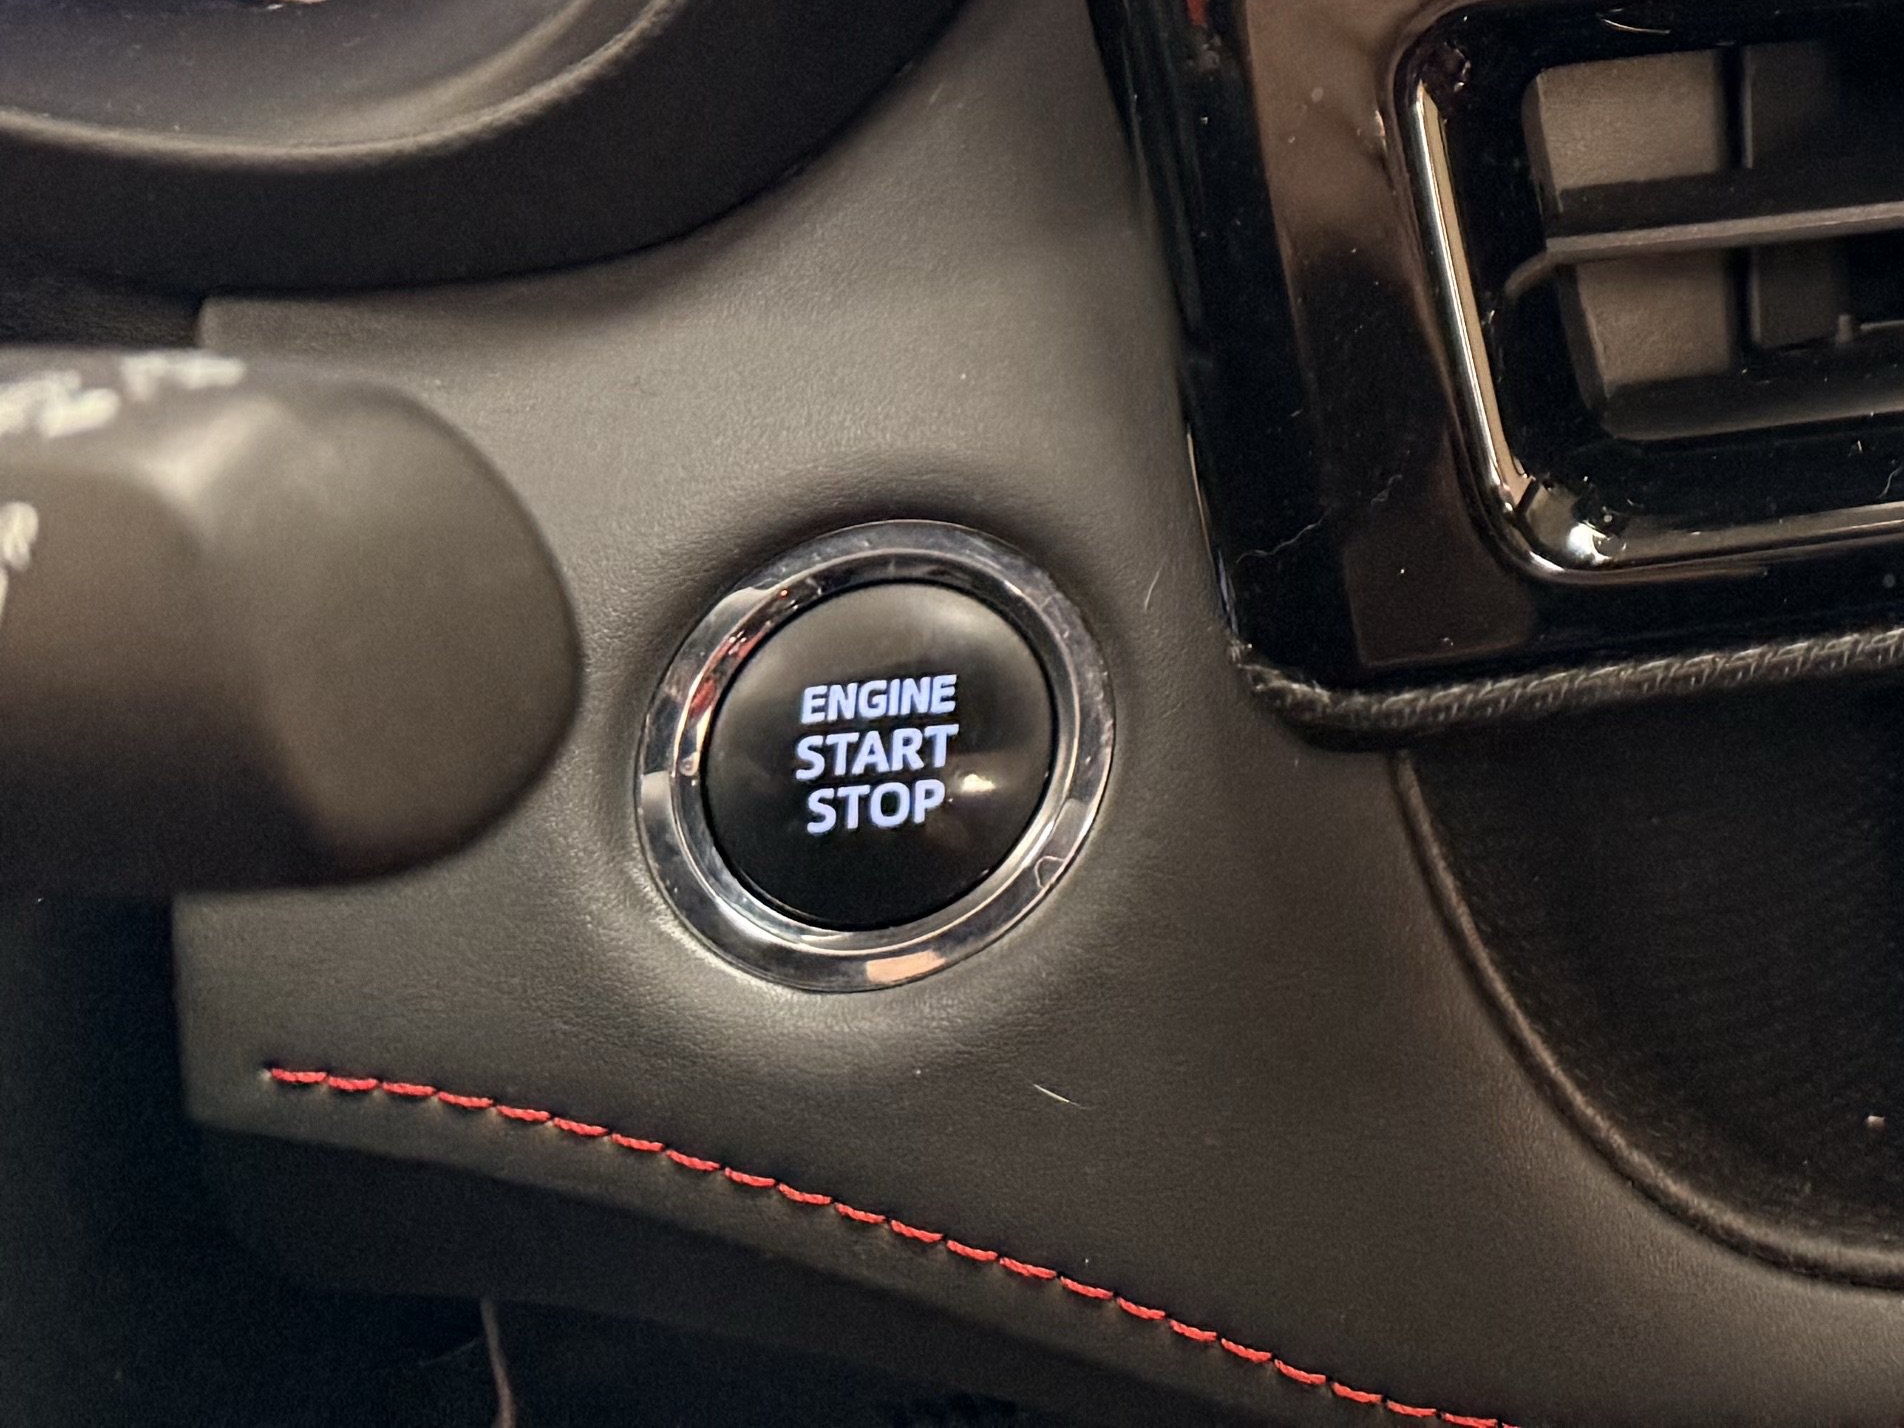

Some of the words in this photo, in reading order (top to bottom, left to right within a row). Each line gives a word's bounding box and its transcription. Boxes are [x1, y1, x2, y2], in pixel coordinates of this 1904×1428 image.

[801, 674, 957, 725] ENGINE
[795, 724, 959, 782] START
[806, 778, 945, 835] STOP
